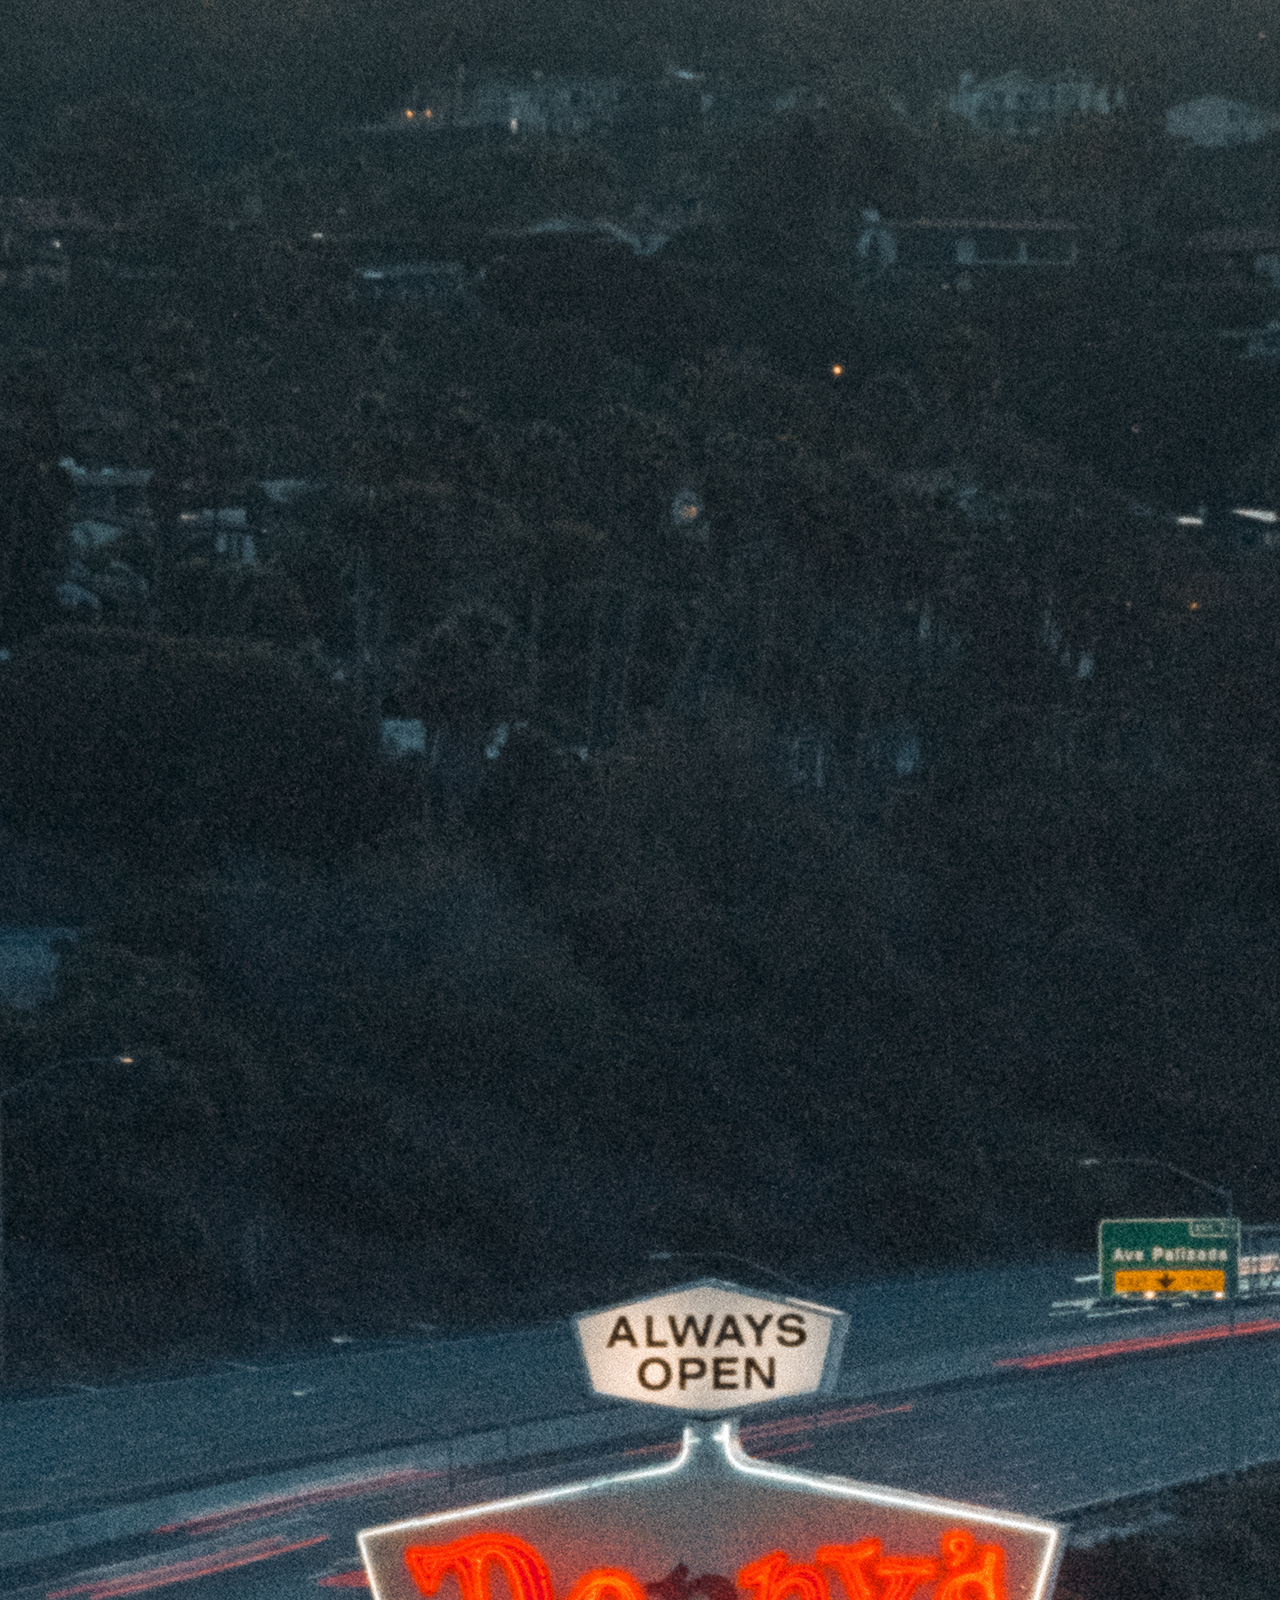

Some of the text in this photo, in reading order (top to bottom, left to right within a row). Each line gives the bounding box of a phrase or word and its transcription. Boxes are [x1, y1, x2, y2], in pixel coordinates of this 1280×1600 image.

[1112, 1247, 1144, 1262] Ave
[606, 1313, 808, 1350] ALWAYS
[637, 1355, 778, 1391] OPEN
